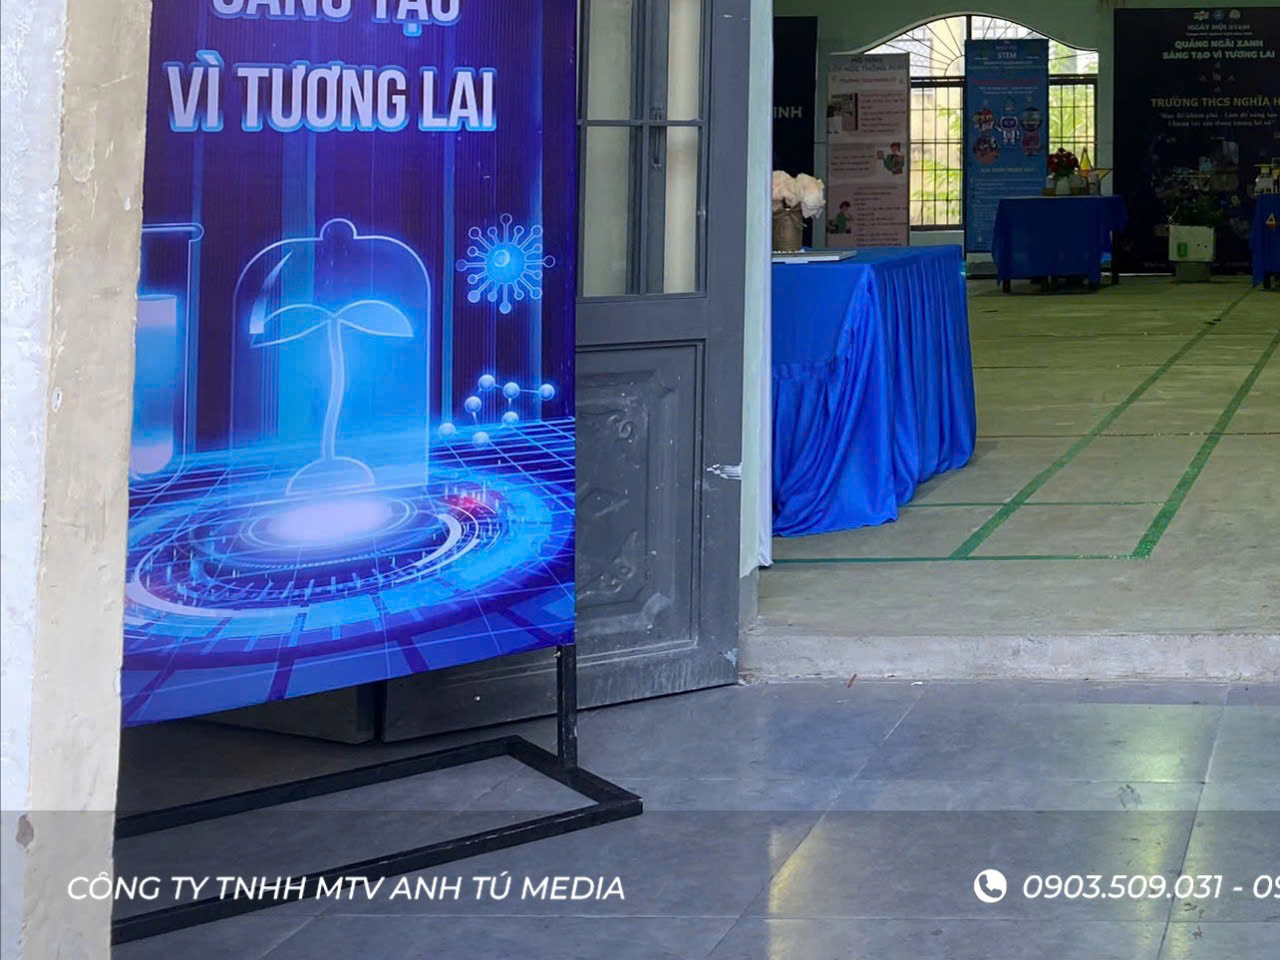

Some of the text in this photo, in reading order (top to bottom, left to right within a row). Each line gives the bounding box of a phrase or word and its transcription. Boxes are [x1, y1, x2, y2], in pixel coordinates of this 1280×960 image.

[165, 51, 496, 131] VÌ TƯƠNG LAI
[1200, 97, 1231, 107] THCS
